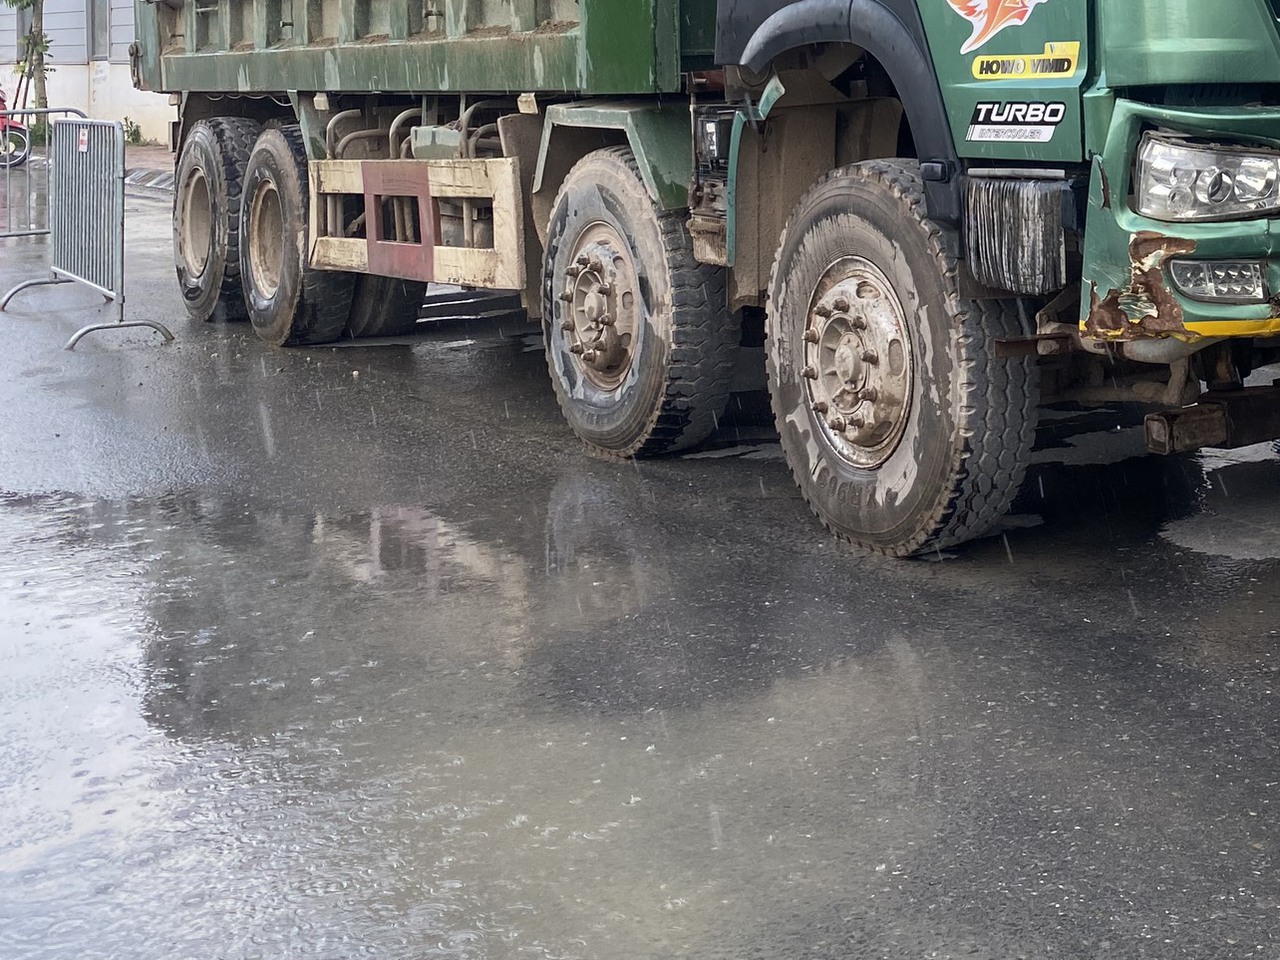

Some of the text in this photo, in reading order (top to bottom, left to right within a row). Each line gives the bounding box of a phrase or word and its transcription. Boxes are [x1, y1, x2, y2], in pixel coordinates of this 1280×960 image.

[979, 58, 1072, 75] HOWO VIMID
[976, 103, 1066, 123] TURBO
